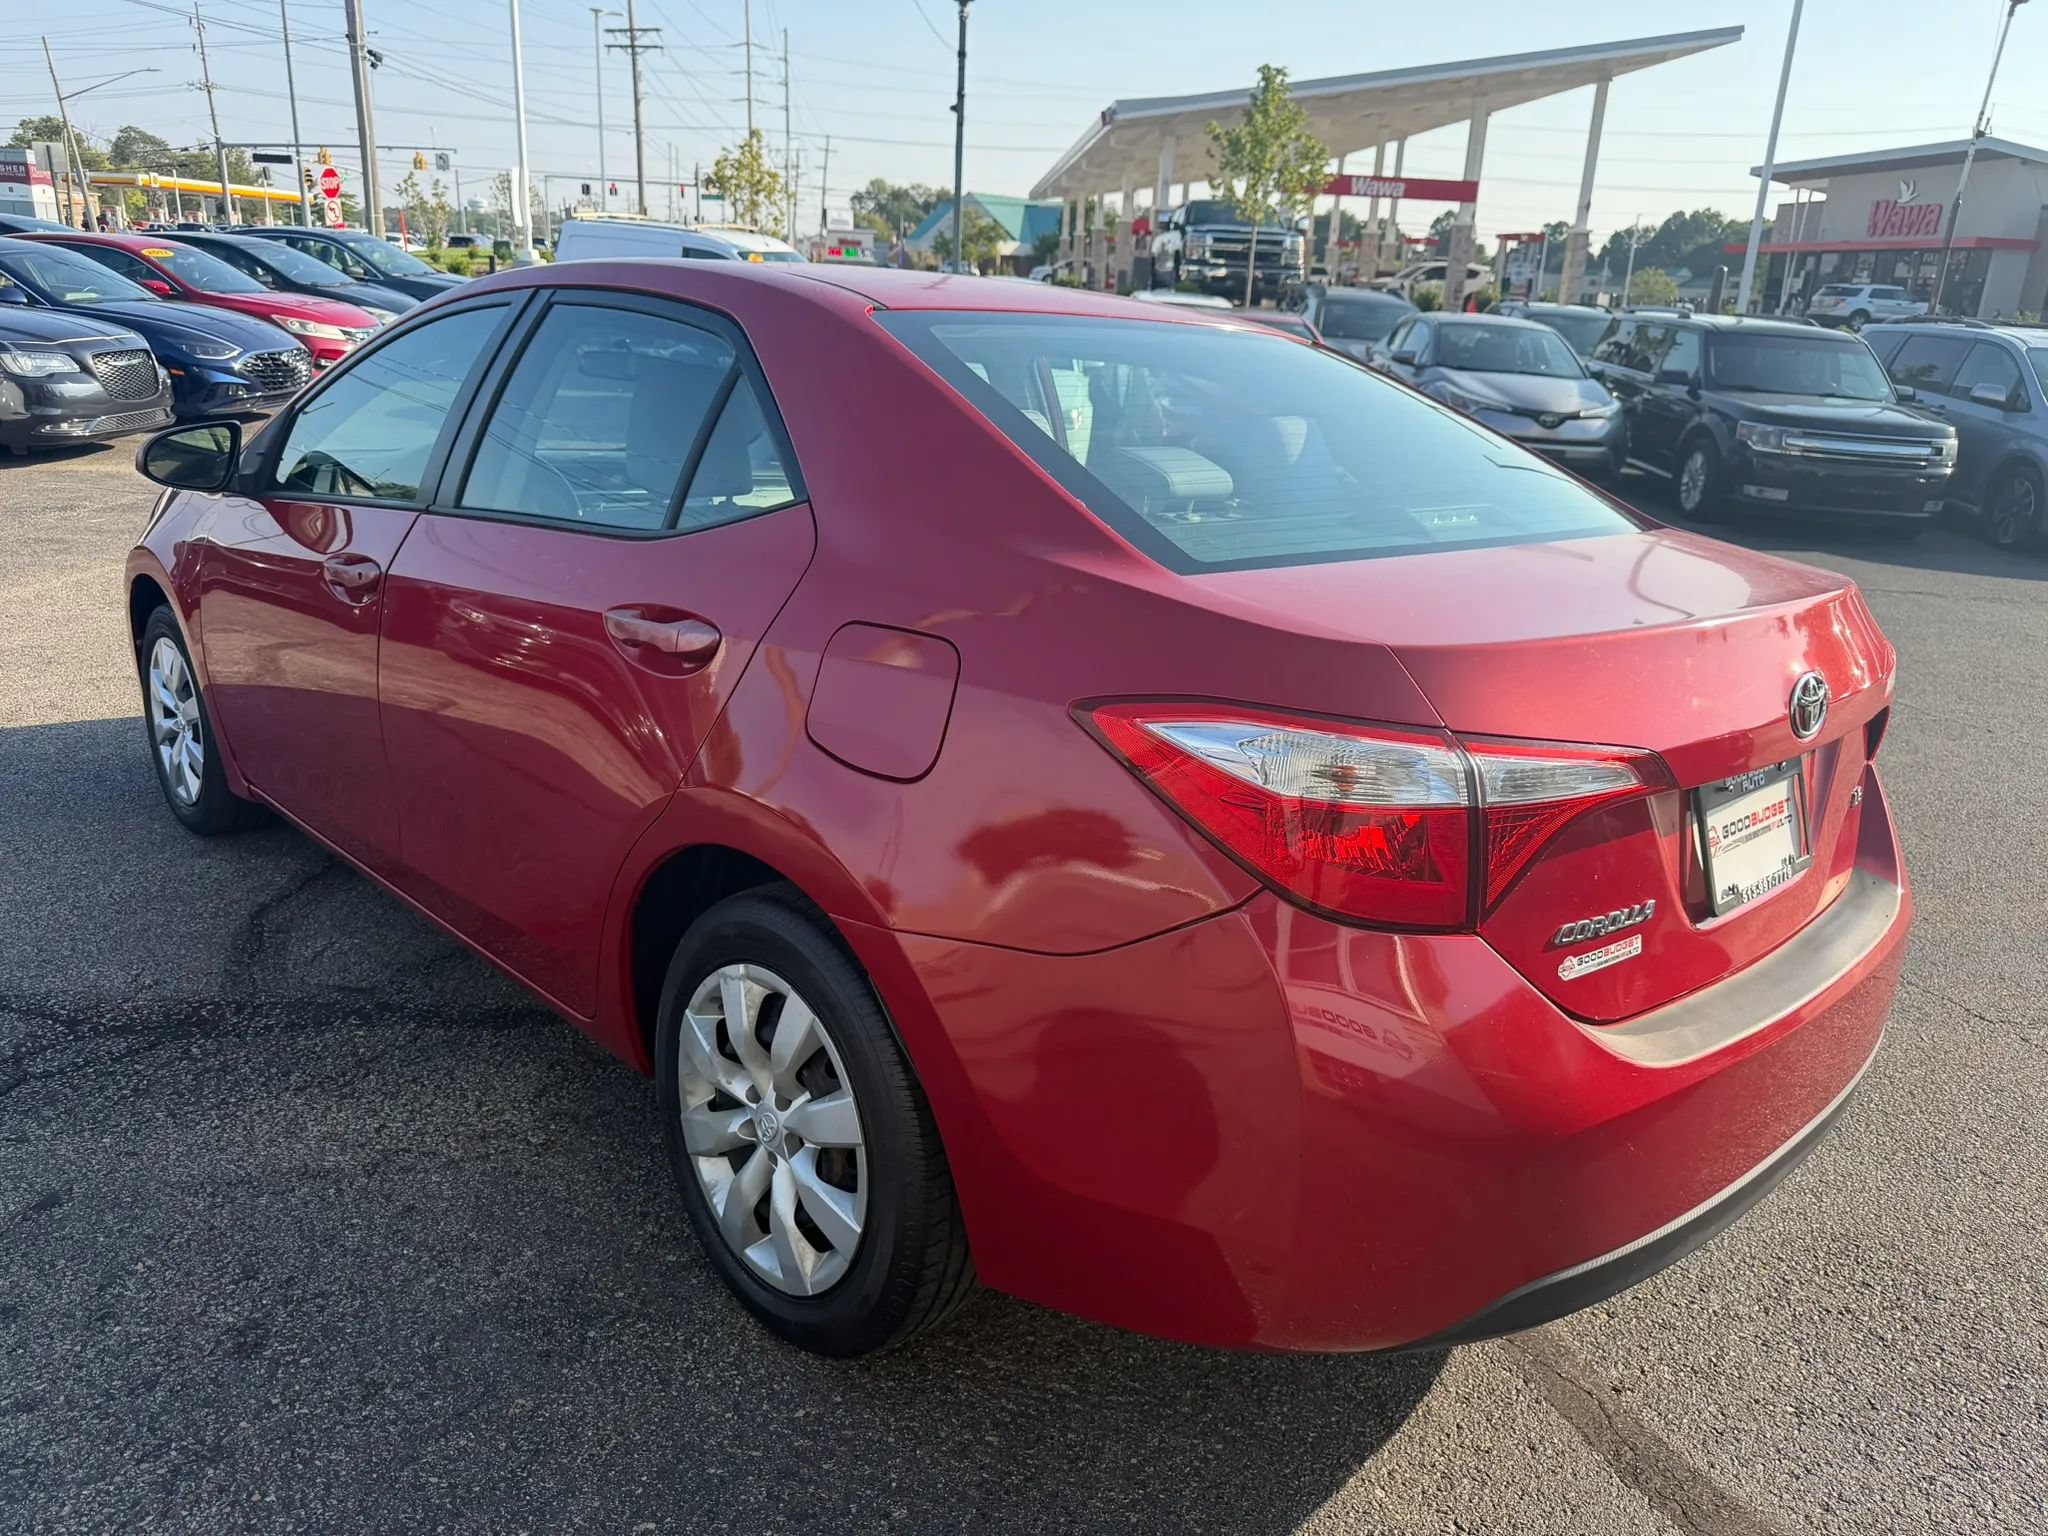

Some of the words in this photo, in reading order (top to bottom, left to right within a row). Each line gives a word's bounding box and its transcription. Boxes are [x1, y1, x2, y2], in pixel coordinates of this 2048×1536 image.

[321, 176, 340, 190] STOP
[1351, 176, 1406, 197] Wawa
[1867, 199, 1943, 237] Wawa
[1742, 774, 1765, 792] AUTO
[1555, 899, 1656, 944] COROLLA
[1577, 936, 1640, 966] GOODBUDGET
